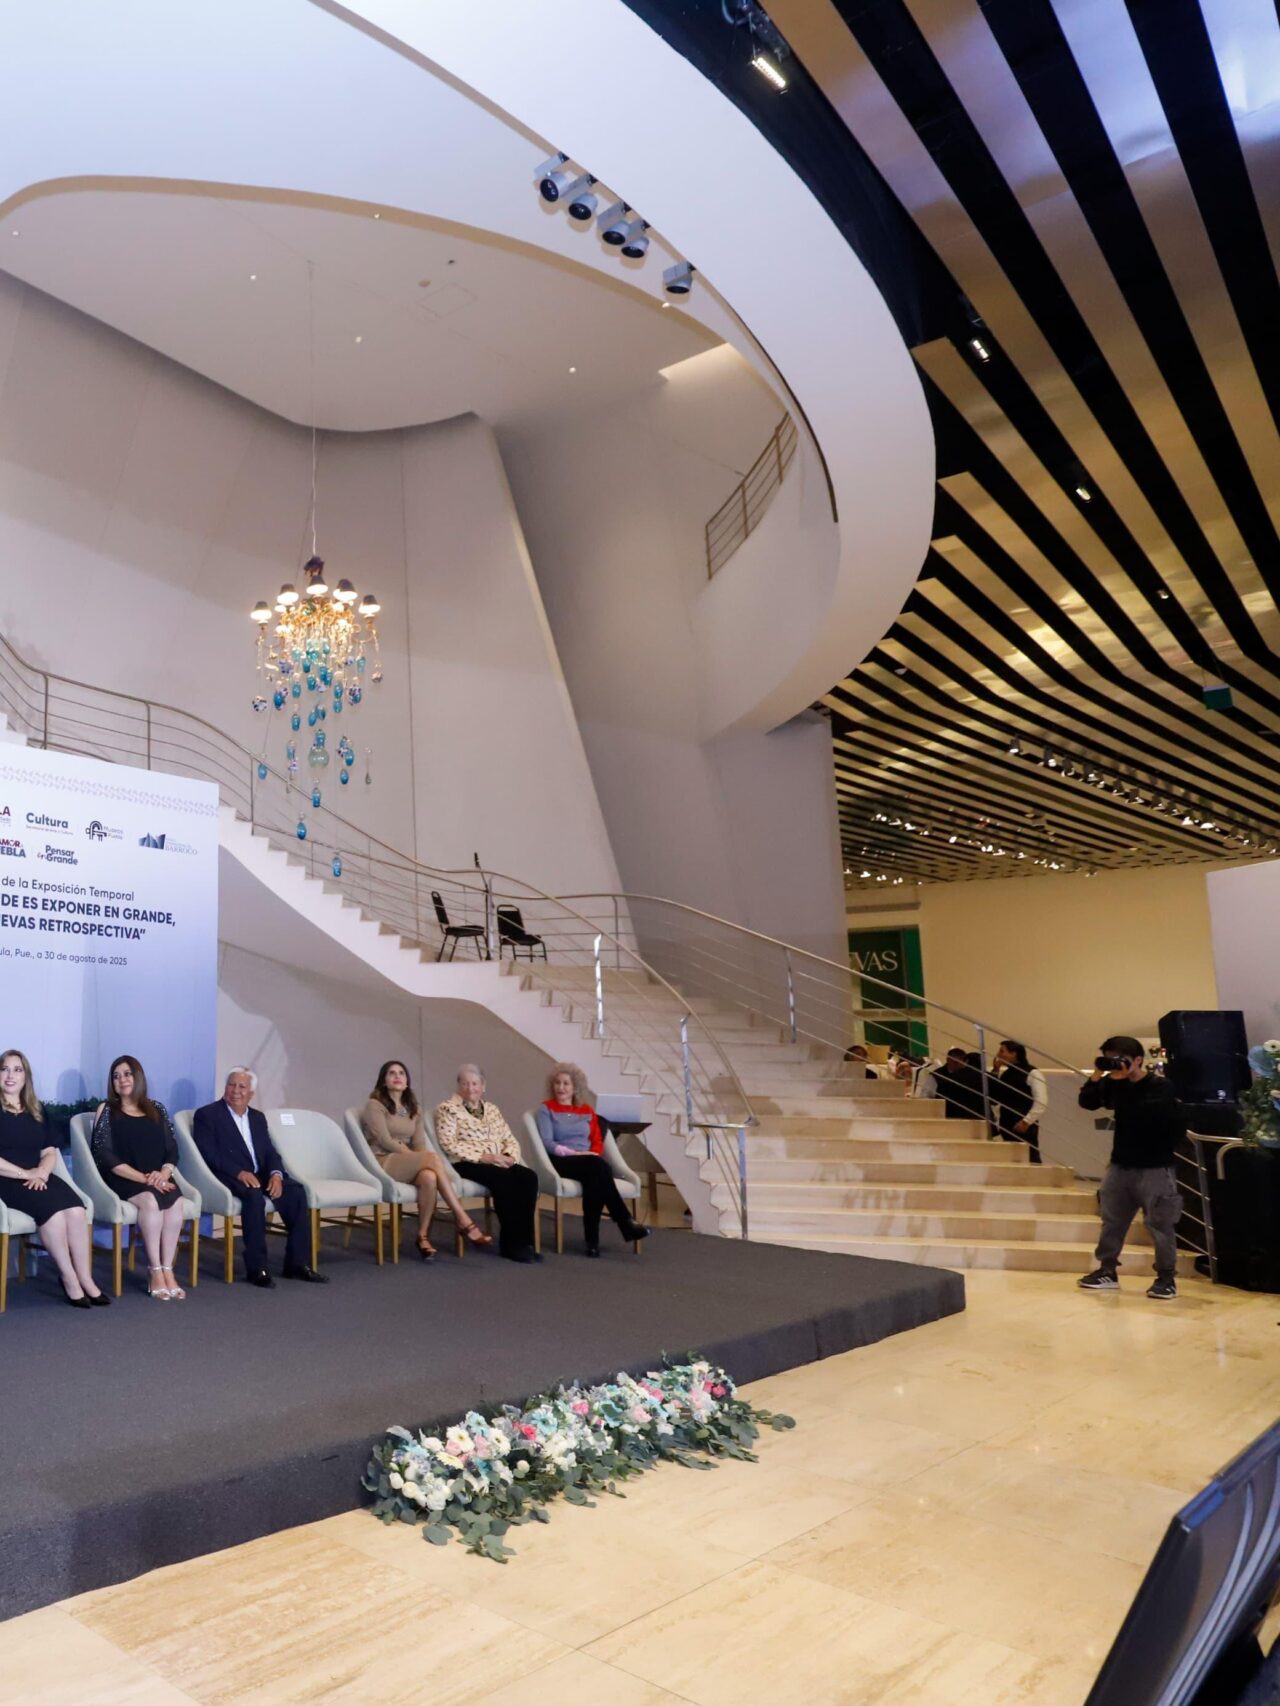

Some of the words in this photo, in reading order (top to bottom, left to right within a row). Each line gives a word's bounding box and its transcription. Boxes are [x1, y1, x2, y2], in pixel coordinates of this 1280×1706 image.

[26, 812, 69, 829] Cultura
[45, 844, 75, 857] Pensar
[46, 853, 78, 866] Grande
[1, 876, 16, 887] de
[18, 877, 29, 889] la
[32, 879, 87, 895] Exposición
[89, 886, 134, 901] Temporal
[22, 896, 38, 910] ES
[41, 898, 101, 917] EXPONER
[104, 905, 120, 918] EN
[122, 907, 176, 927] GRANDE,
[15, 949, 35, 959] Pue.,
[44, 951, 55, 960] 30
[56, 951, 67, 961] de
[69, 954, 96, 964] agosto
[98, 956, 108, 964] de
[109, 956, 128, 966] 2025
